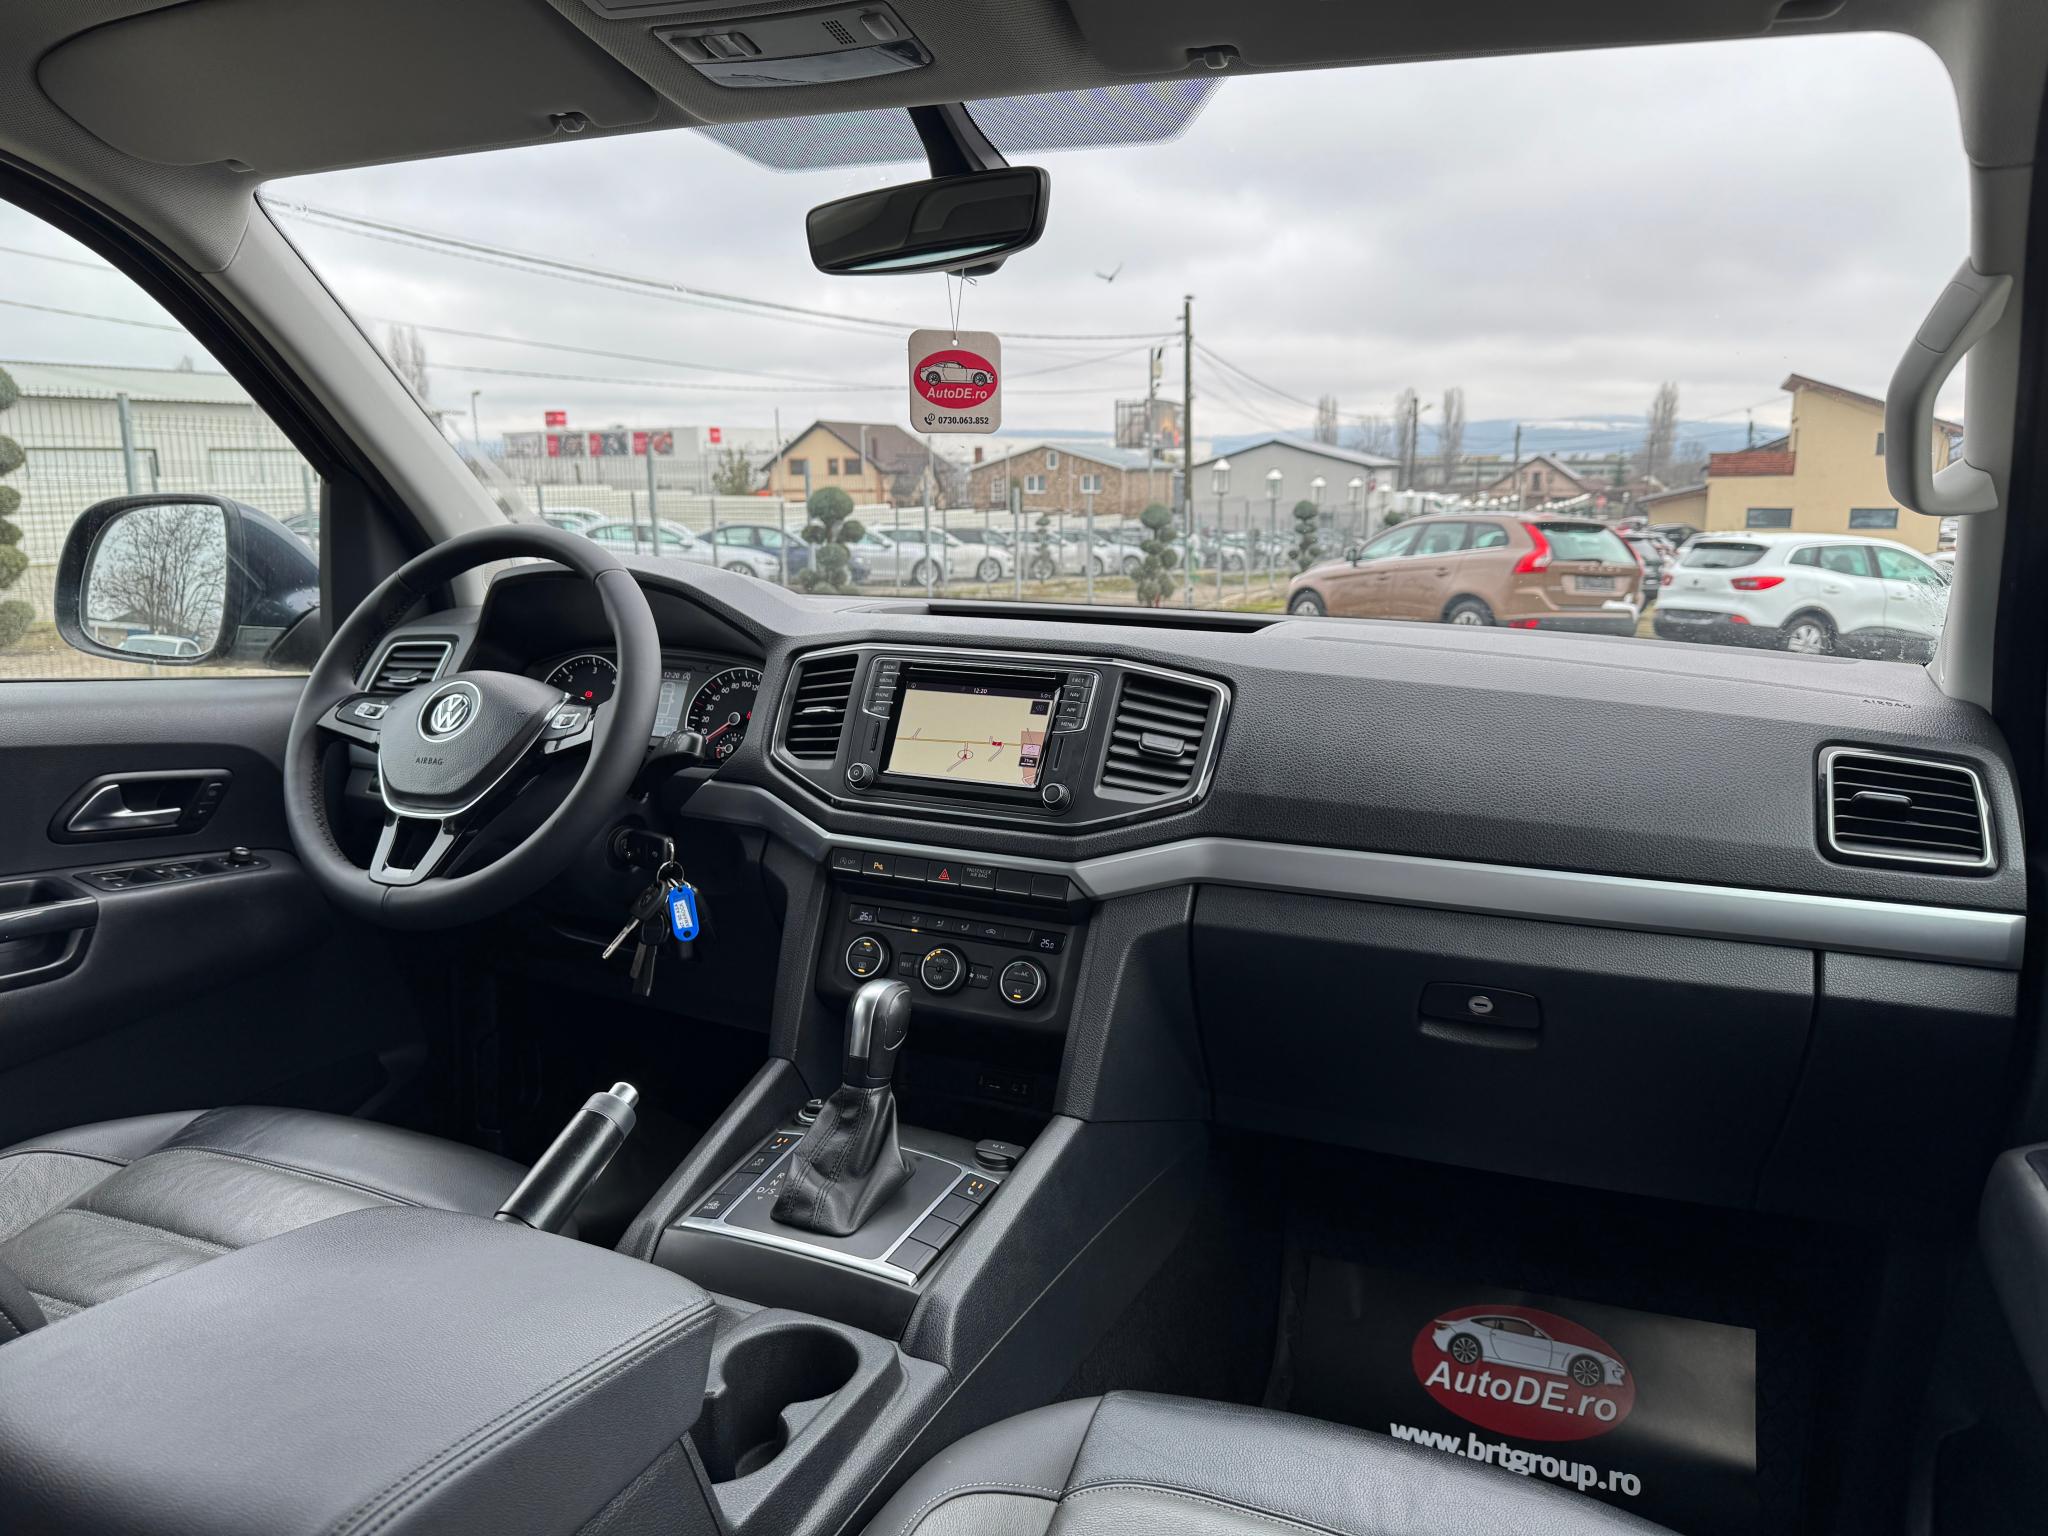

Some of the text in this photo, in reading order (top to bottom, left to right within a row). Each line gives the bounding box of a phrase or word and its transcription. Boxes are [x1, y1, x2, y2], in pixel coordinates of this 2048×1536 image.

[926, 388, 987, 399] AutoDE.ro
[938, 416, 989, 425] 0730.063.852
[741, 680, 752, 688] 100
[711, 694, 721, 702] 40
[1862, 699, 1911, 709] AIRBAG
[415, 757, 443, 765] AIRBAG
[1424, 1359, 1618, 1423] AutoDE.ro
[1389, 1421, 1642, 1497] www.brtgroup.ro
